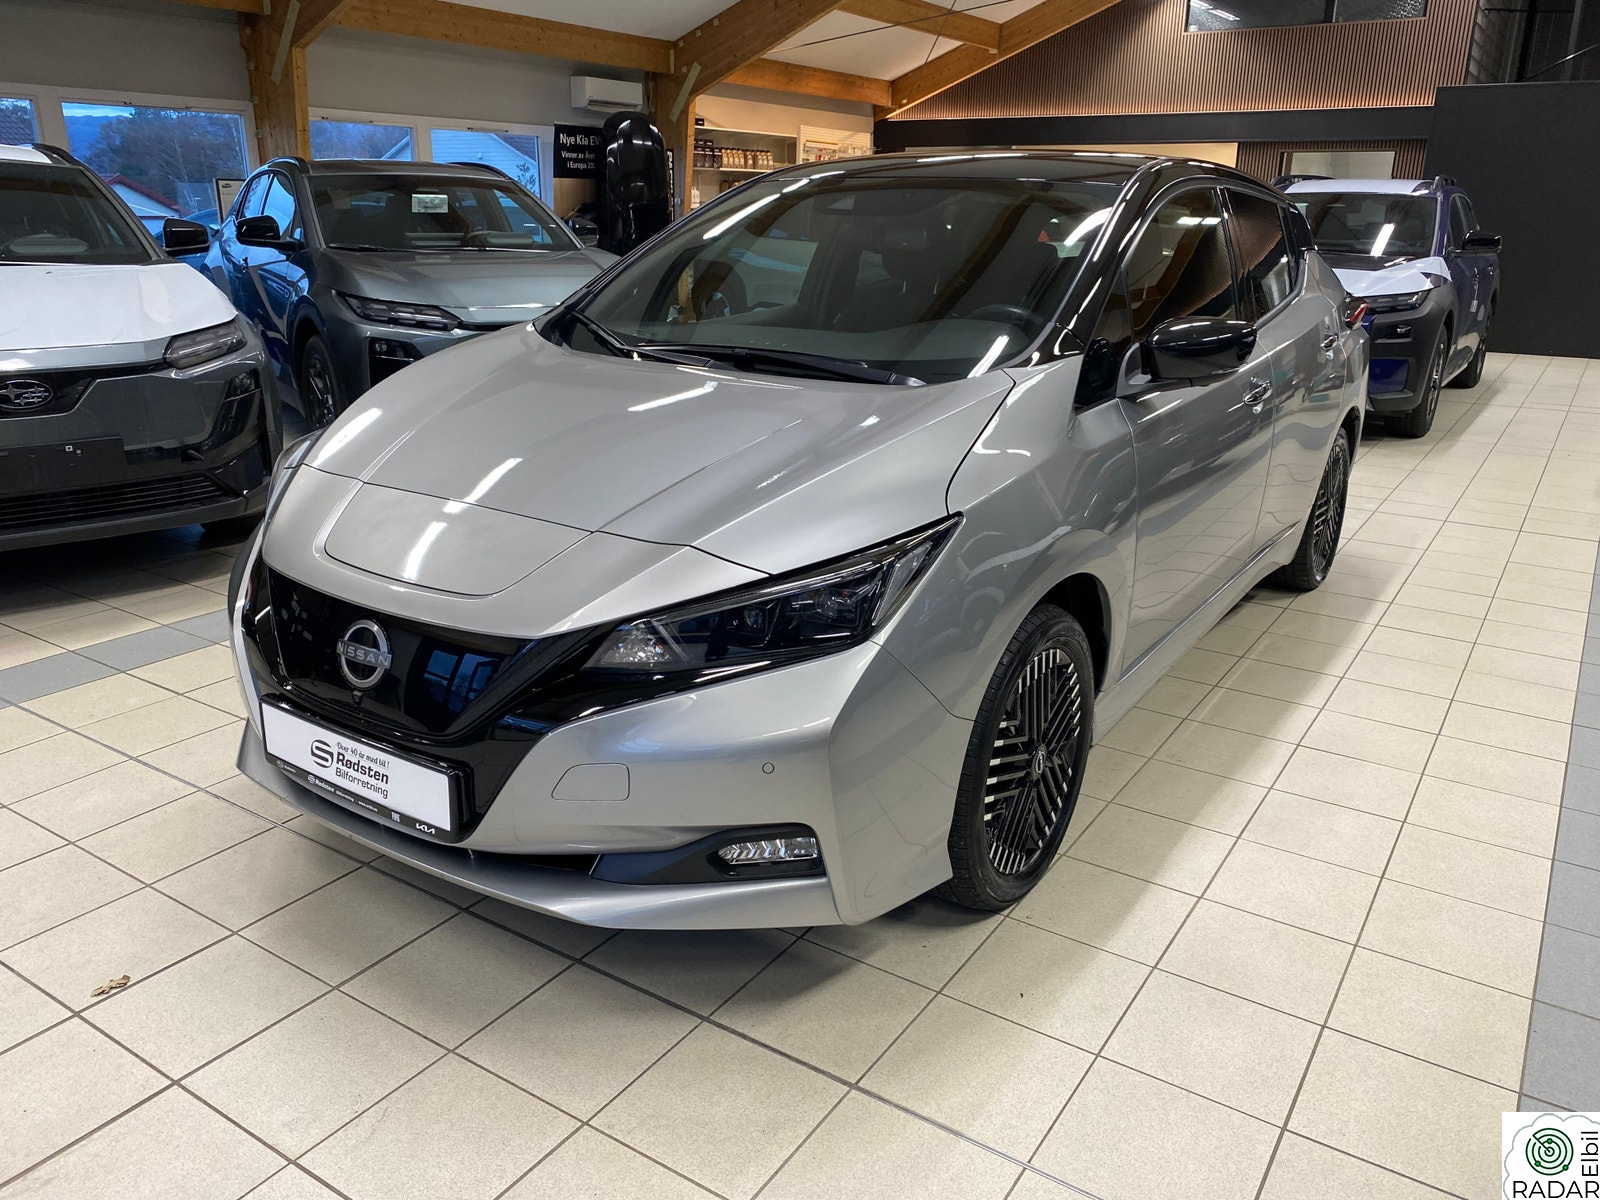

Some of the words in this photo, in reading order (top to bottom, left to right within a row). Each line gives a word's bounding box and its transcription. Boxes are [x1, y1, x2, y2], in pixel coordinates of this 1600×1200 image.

[560, 133, 575, 147] Nye
[576, 134, 589, 146] Kia
[590, 135, 601, 146] EV
[561, 150, 578, 159] Vinner
[570, 161, 587, 170] Europa
[337, 640, 390, 667] NISSAN
[351, 747, 358, 756] 40
[366, 755, 378, 764] med
[336, 751, 389, 785] Rødsten
[335, 767, 389, 799] Bilforretning
